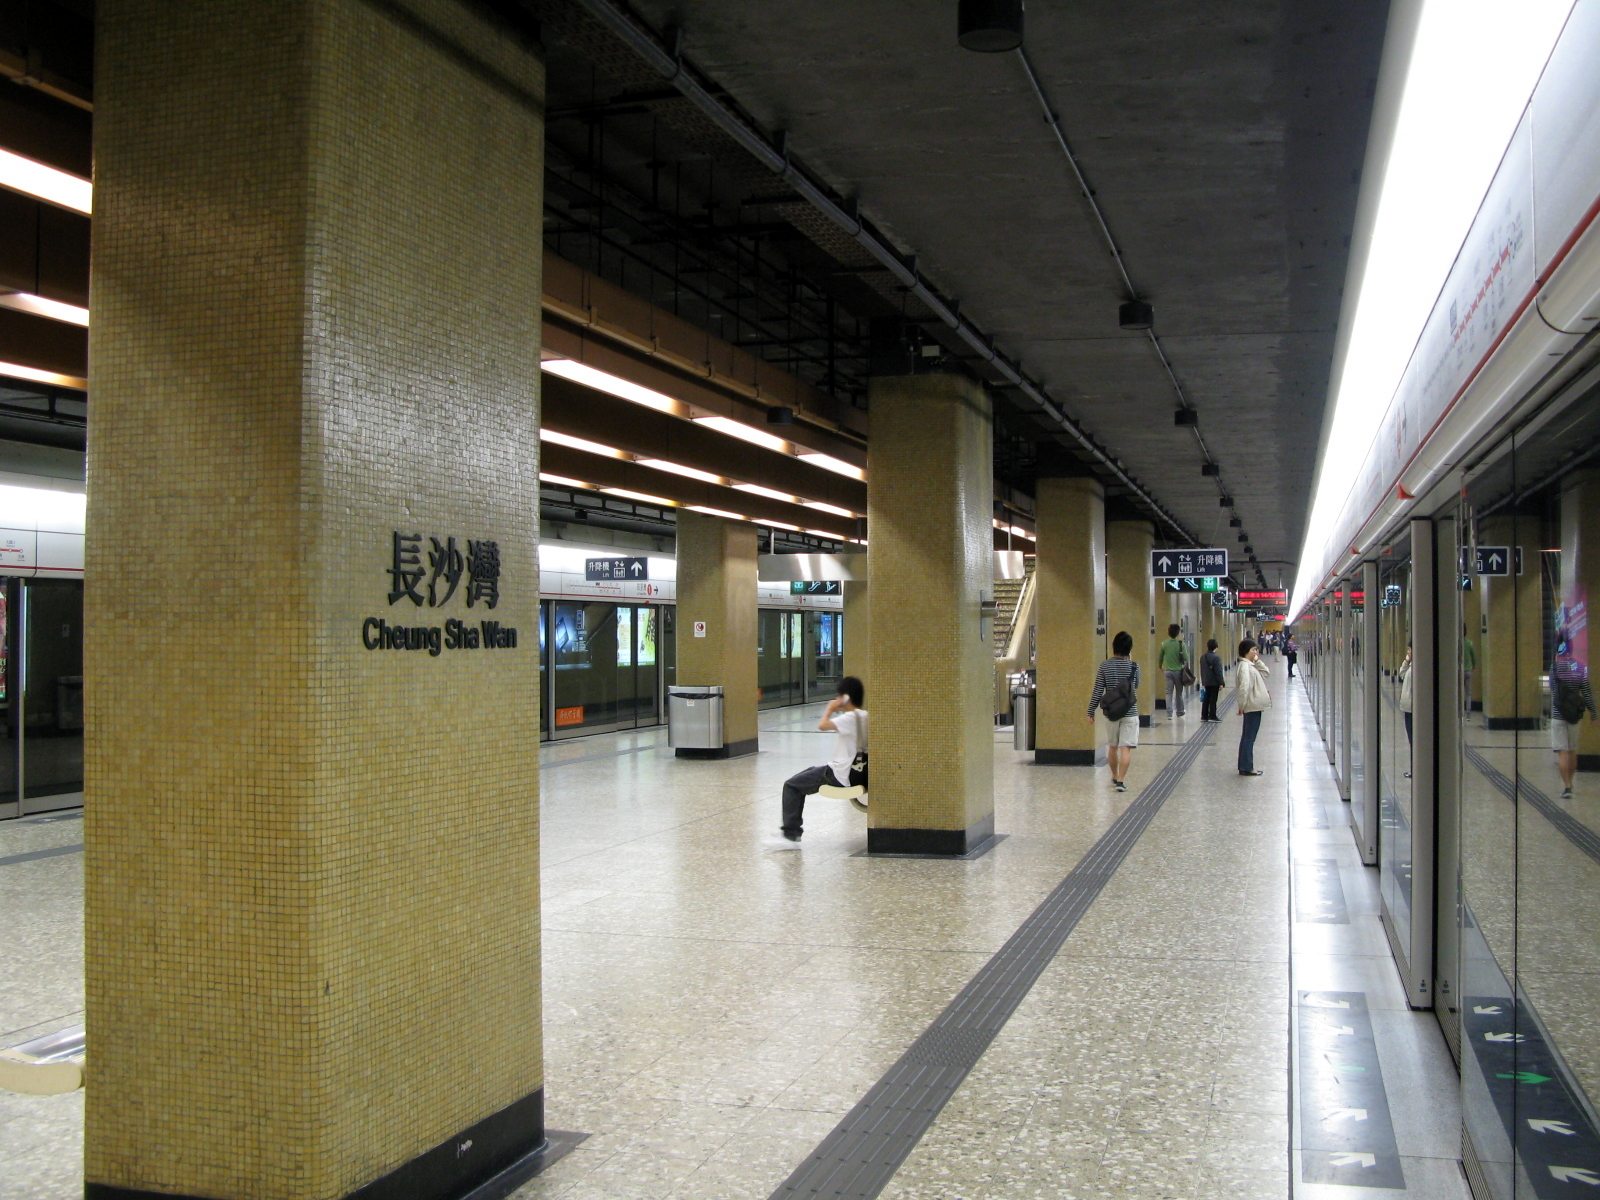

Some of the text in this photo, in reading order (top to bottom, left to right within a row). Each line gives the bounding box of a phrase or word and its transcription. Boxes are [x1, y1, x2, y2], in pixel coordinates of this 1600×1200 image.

[387, 531, 501, 609] 長沙灣
[588, 561, 610, 572] 升降機
[1197, 554, 1223, 565] 升降機
[363, 616, 517, 657] Cheung Sha Wan
